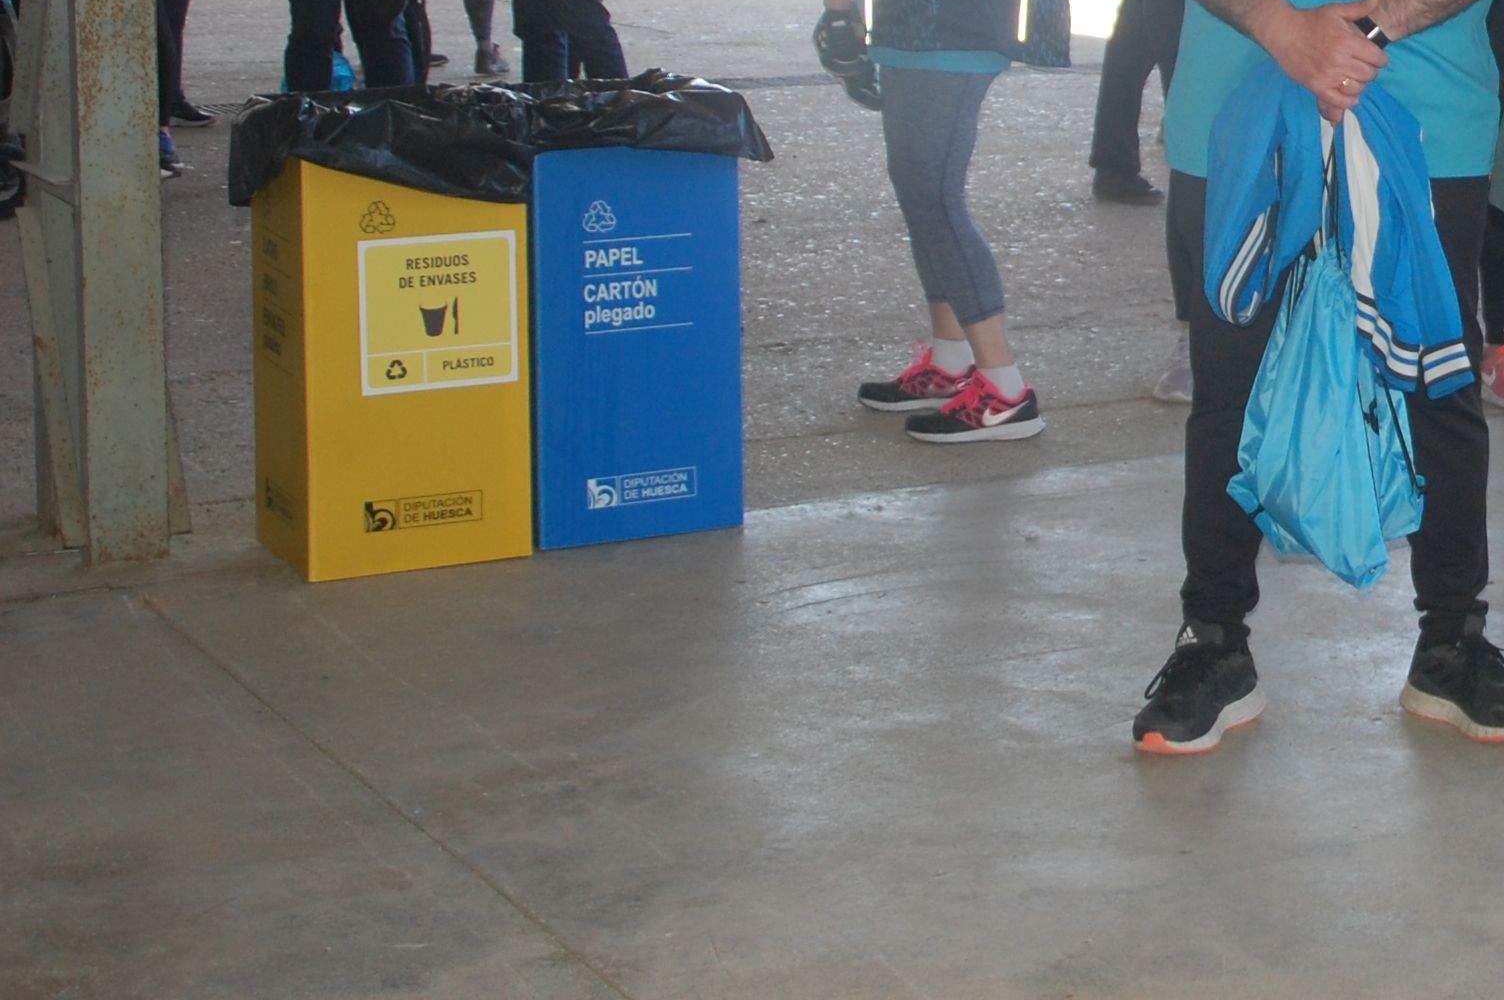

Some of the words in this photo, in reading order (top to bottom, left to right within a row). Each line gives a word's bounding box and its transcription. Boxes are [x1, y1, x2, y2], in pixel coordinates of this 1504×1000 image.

[406, 254, 470, 270] RESIDUOS
[584, 247, 644, 269] PAPEL
[398, 277, 414, 289] DE
[419, 271, 477, 288] ENVASES
[584, 275, 658, 303] CARTÓN
[584, 301, 656, 329] plegado
[442, 356, 495, 370] PLÁSTICO
[624, 472, 688, 489] DIPUTACIÓN
[624, 488, 639, 500] DE
[641, 483, 688, 498] HUESCA
[403, 495, 473, 512] DIPUTACIÓN
[404, 512, 419, 524] DE
[423, 507, 473, 521] HUESCA
